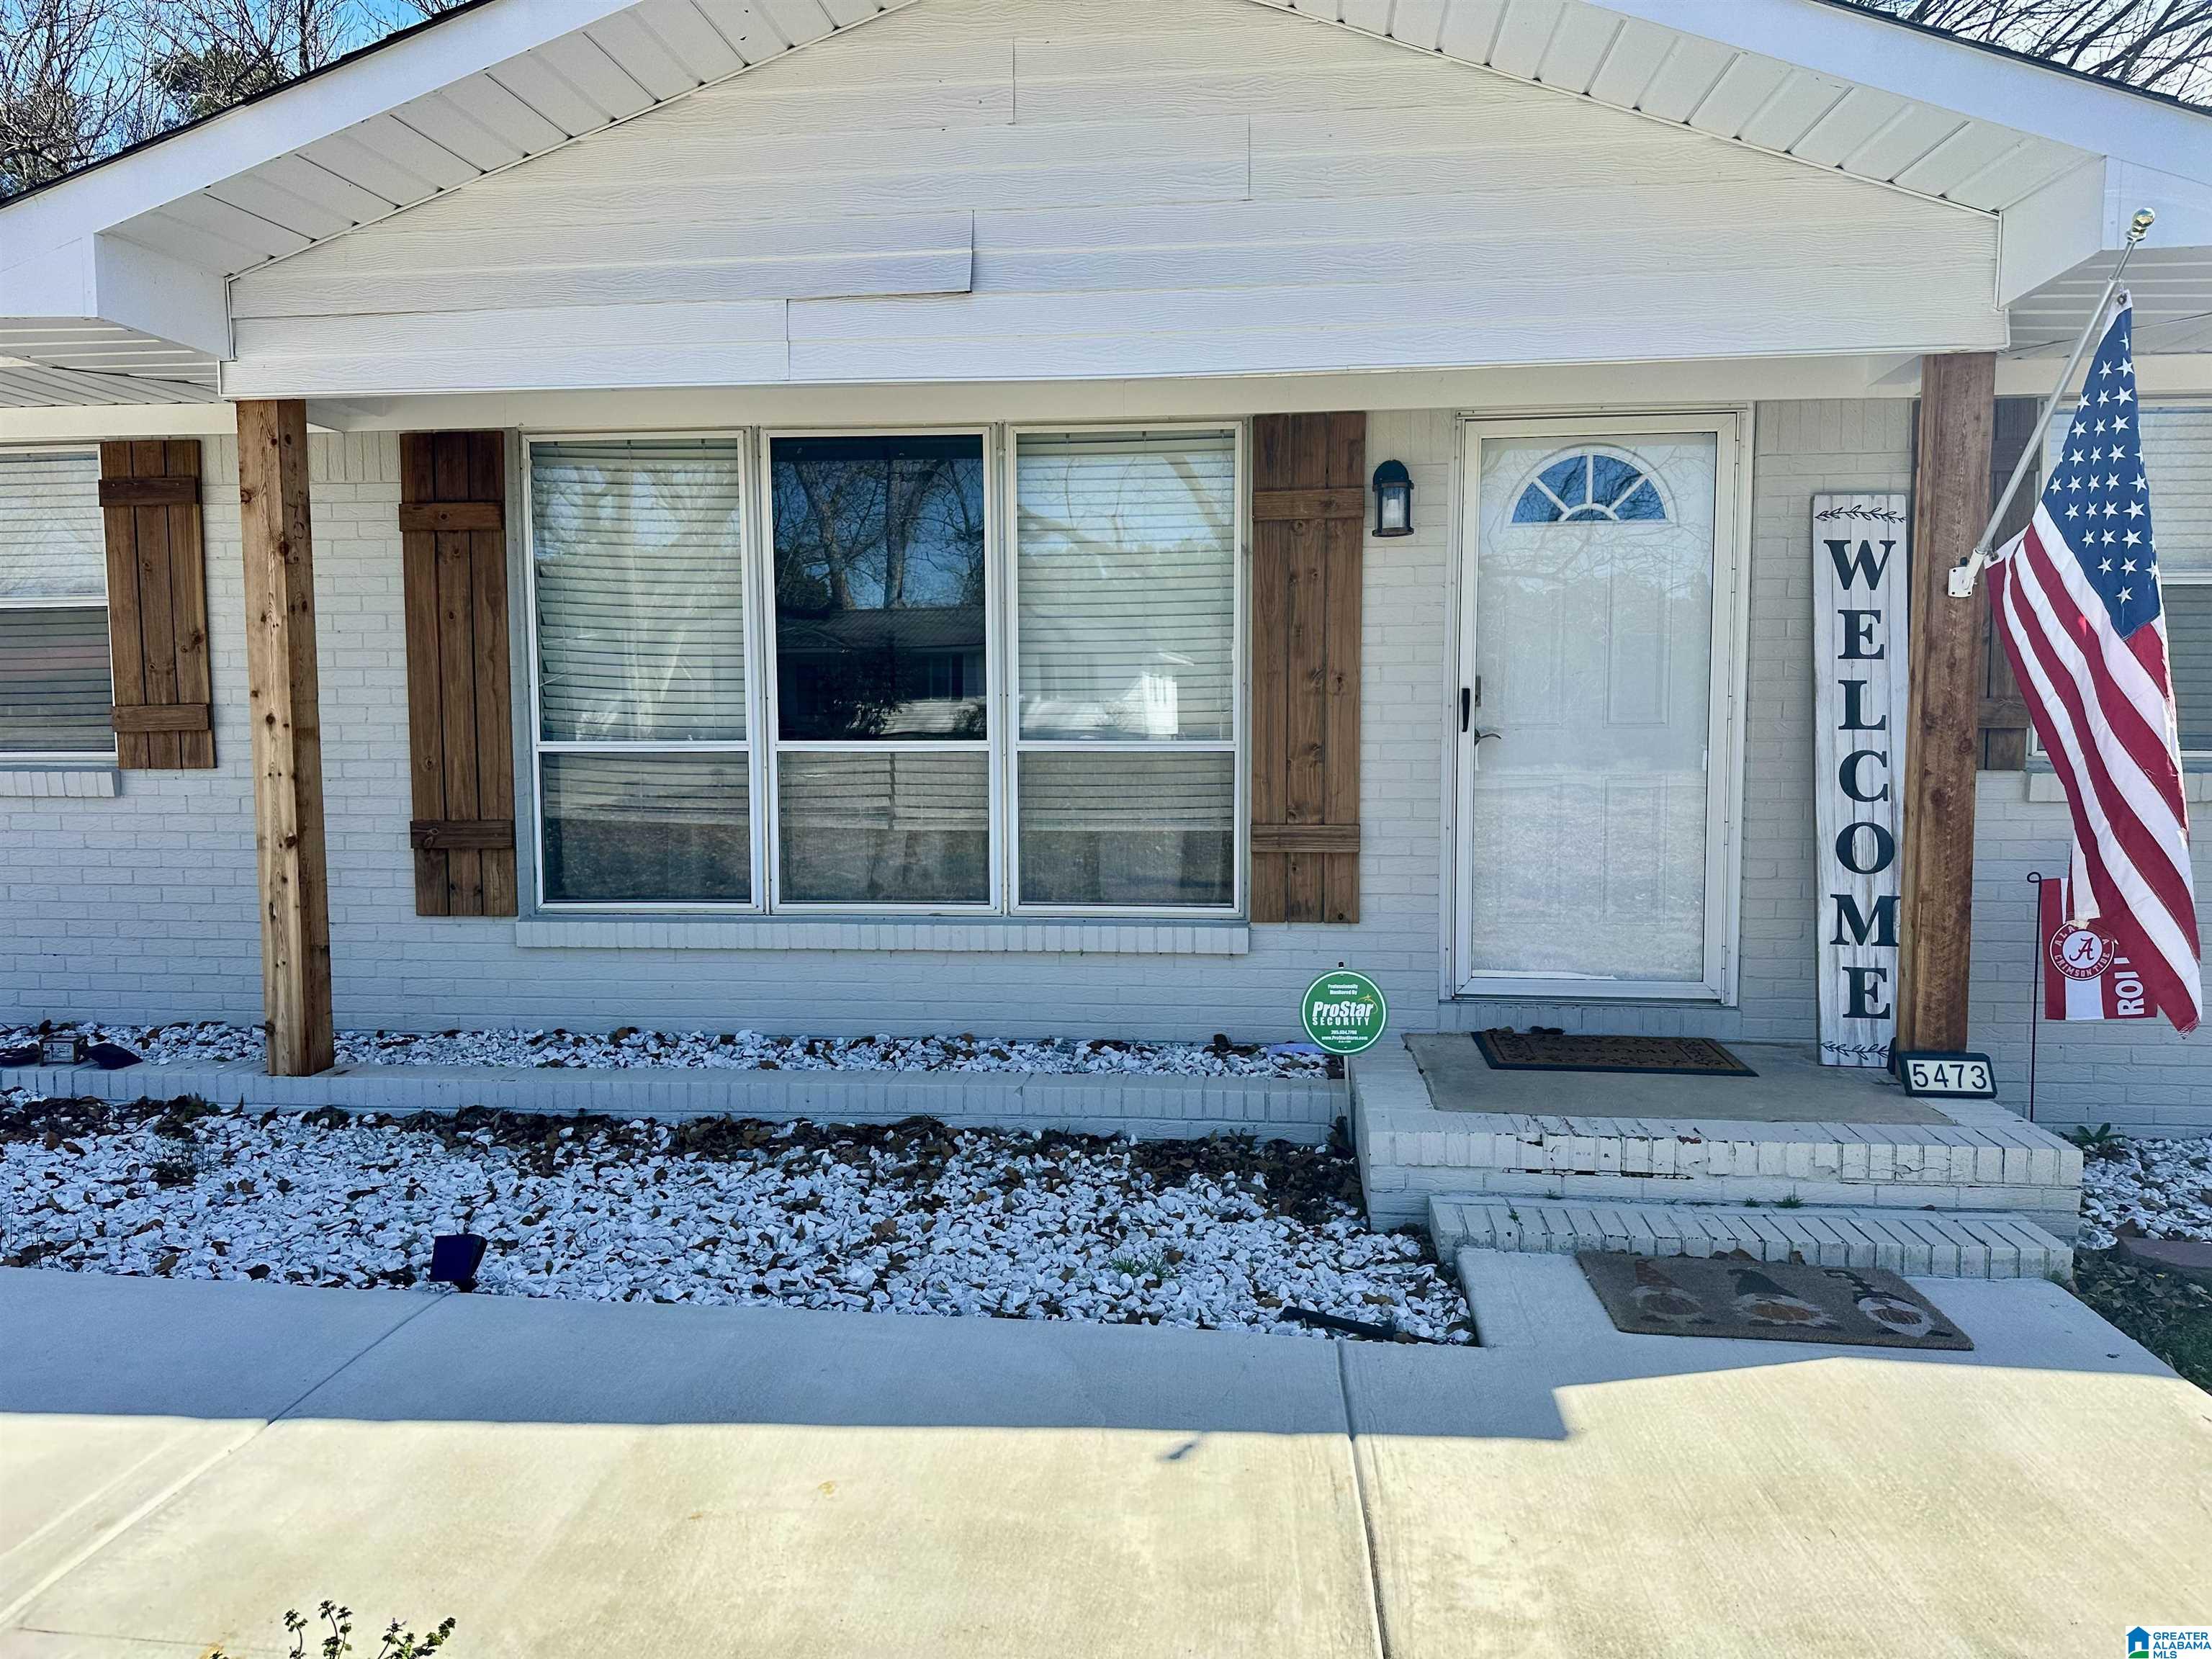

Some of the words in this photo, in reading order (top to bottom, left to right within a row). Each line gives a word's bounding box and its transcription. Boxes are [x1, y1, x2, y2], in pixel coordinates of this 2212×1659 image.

[1823, 539, 1899, 1020] WELCOME
[2069, 937, 2095, 961] A
[2054, 954, 2092, 977] CRIMSON
[2093, 953, 2110, 972] TIDE
[1312, 1001, 1374, 1017] ProStar
[1312, 1017, 1370, 1026] SECURITY
[1912, 1064, 1987, 1089] 5473
